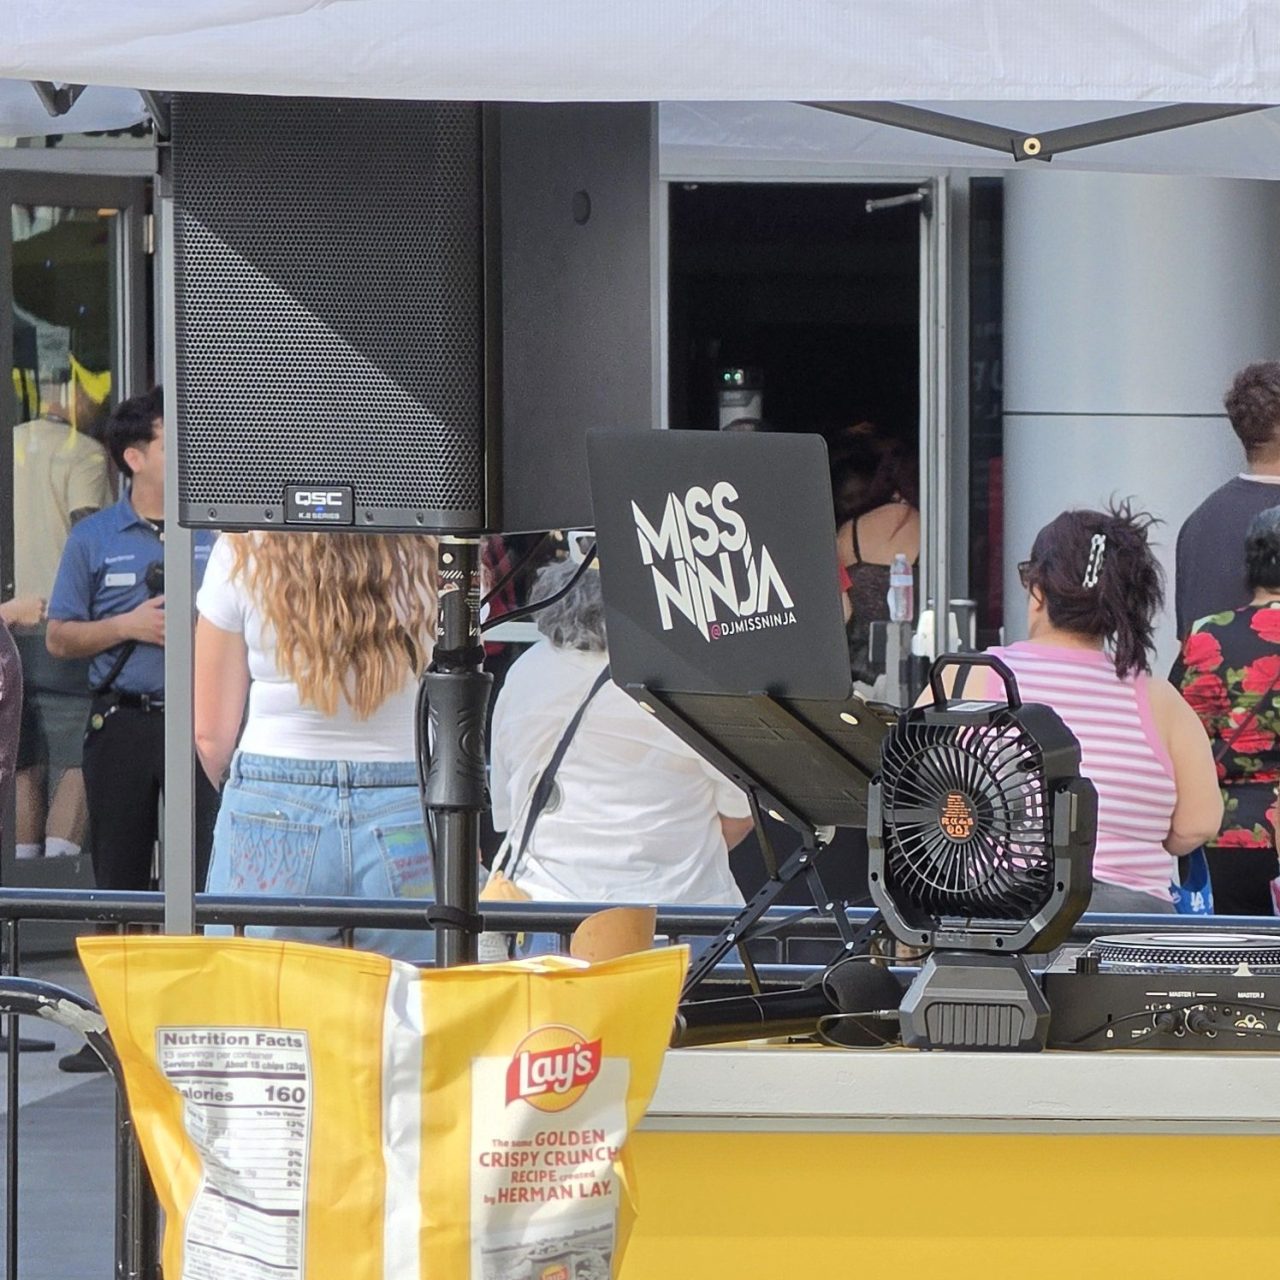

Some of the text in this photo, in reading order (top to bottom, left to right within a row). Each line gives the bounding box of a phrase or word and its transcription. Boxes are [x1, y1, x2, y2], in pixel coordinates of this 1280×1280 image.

[295, 491, 343, 506] QSC
[631, 481, 747, 574] MISS
[651, 532, 795, 643] NINJA
[710, 611, 797, 640] @DJMISSNINJA
[163, 1033, 303, 1048] Nutrition Facts
[519, 1042, 594, 1098] Lay's
[265, 1085, 306, 1103] 160
[535, 1129, 606, 1148] GOLDEN
[479, 1146, 620, 1168] CRISPY CRUNCH
[510, 1169, 558, 1183] RECIPE
[497, 1184, 574, 1204] HERMAN
[579, 1179, 612, 1198] LAY.
